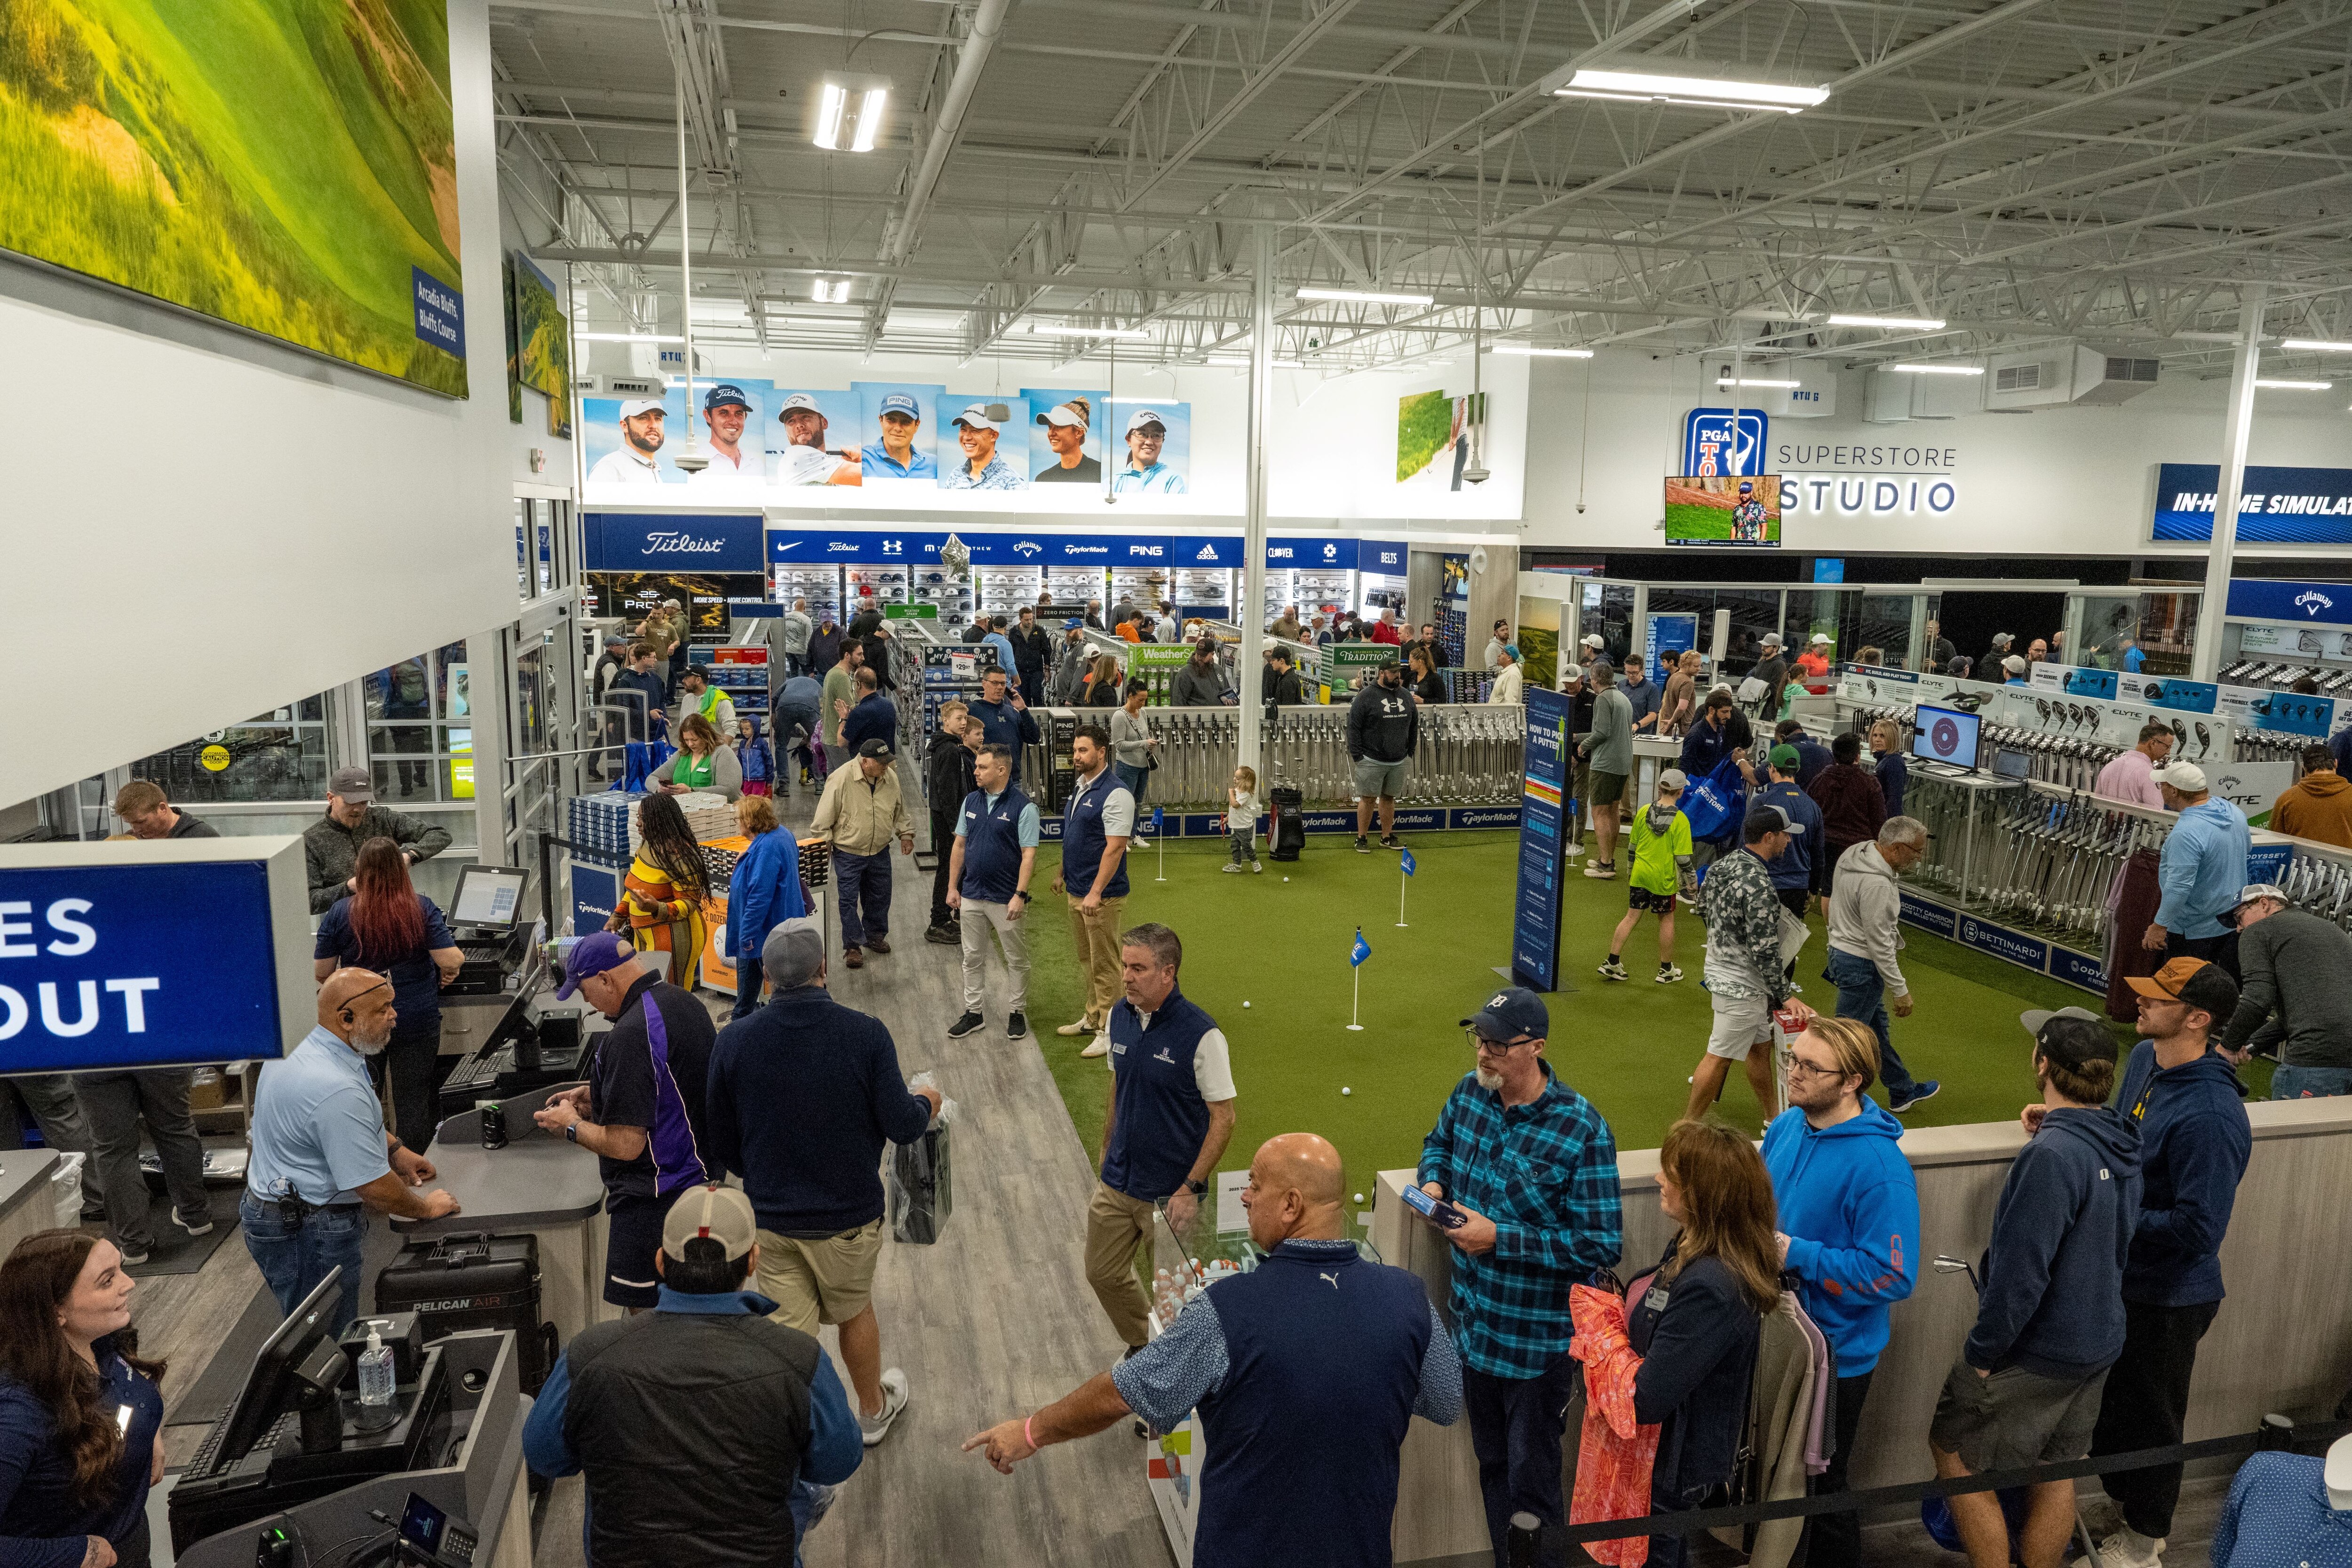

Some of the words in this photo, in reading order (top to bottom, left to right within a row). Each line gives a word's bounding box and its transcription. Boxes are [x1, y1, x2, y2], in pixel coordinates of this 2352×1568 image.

[419, 282, 440, 308] Arcadia
[441, 294, 458, 320] Bluffs,
[419, 309, 437, 333] Bluffs
[438, 318, 456, 342] Course
[715, 389, 745, 401] Titleist
[1701, 430, 1731, 442] PGA
[1699, 442, 1719, 477] TO
[1779, 445, 1956, 467] SUPERSTORE
[1780, 480, 1955, 512] STUDIO
[2173, 493, 2264, 514] IN-HME
[642, 531, 724, 554] Titleist
[827, 542, 859, 551] Titleist
[1013, 541, 1042, 552] Callaway
[1065, 545, 1108, 554] TaylorMade
[1130, 546, 1163, 556] PING
[1381, 552, 1397, 564] BELTS
[2295, 590, 2334, 608] Callaway
[1340, 651, 1393, 661] TRADITION
[2111, 709, 2142, 718] ELYTE
[1529, 724, 1542, 734] HOW
[1543, 728, 1550, 737] TO
[1552, 730, 1564, 741] PICK
[1538, 738, 1559, 750] PUTTER
[2218, 775, 2241, 785] Callaway
[1462, 812, 1518, 825] TaylorMade
[1040, 823, 1061, 835] NG
[1136, 820, 1155, 832] NG
[579, 901, 611, 916] TaylorMade
[1901, 901, 1922, 912] SCOTTY
[1924, 909, 1953, 924] CAMERON
[706, 912, 709, 921] 2
[710, 914, 727, 925] DOZEN
[1913, 911, 1929, 920] MILLED
[1930, 916, 1950, 928] PUTTERS
[1979, 931, 2041, 959] BETTINARDI
[2080, 966, 2110, 980] ODYS
[1153, 1054, 1175, 1064] SUPERSTORE
[413, 1298, 470, 1312] PELICAN
[474, 1297, 501, 1307] AIR
